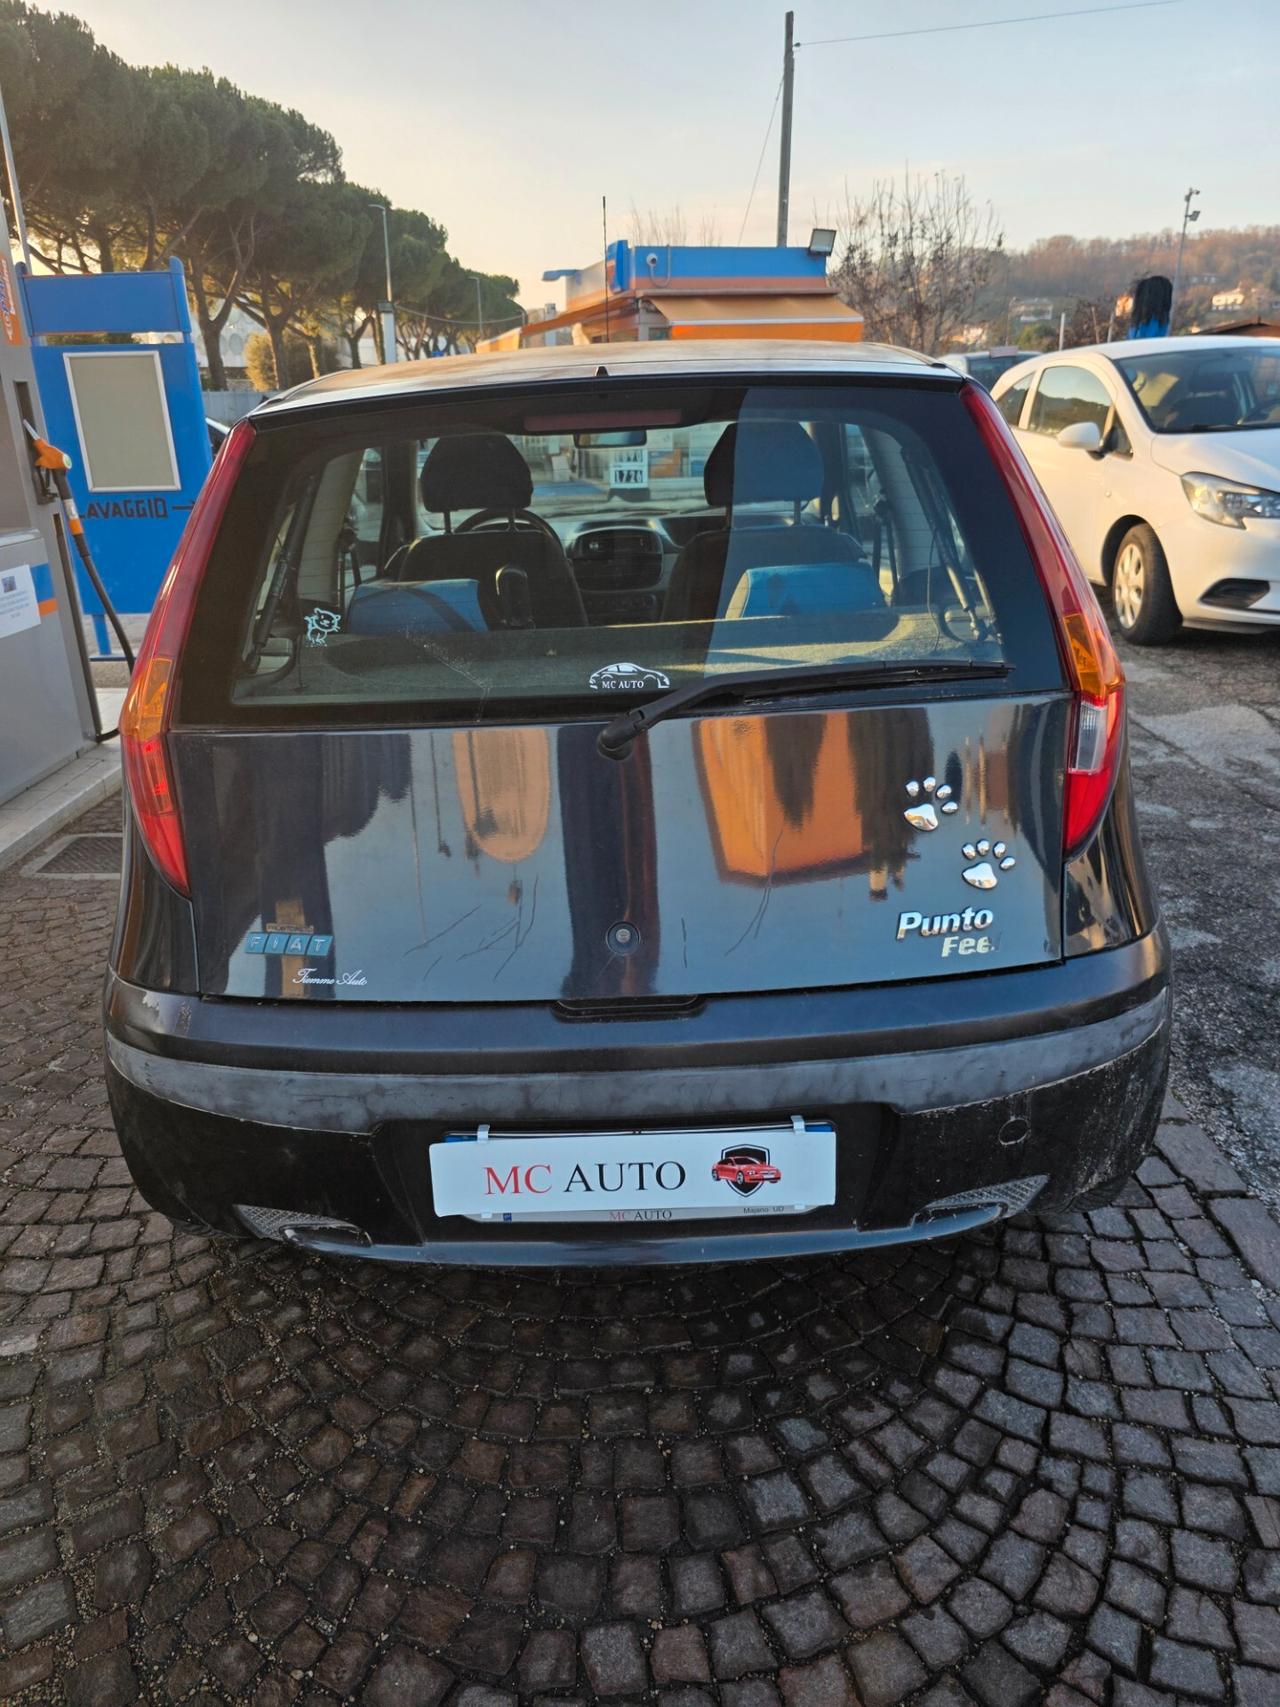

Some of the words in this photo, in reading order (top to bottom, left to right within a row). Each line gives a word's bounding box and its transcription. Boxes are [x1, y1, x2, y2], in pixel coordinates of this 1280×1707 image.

[601, 680, 617, 689] MC
[618, 680, 644, 689] AUTO
[896, 906, 994, 940] Punto
[249, 936, 326, 951] FIAT
[336, 969, 368, 986] Auto
[483, 1164, 552, 1195] MC
[563, 1160, 686, 1193] AUTO
[609, 1210, 632, 1222] MC
[634, 1209, 672, 1221] AUTO
